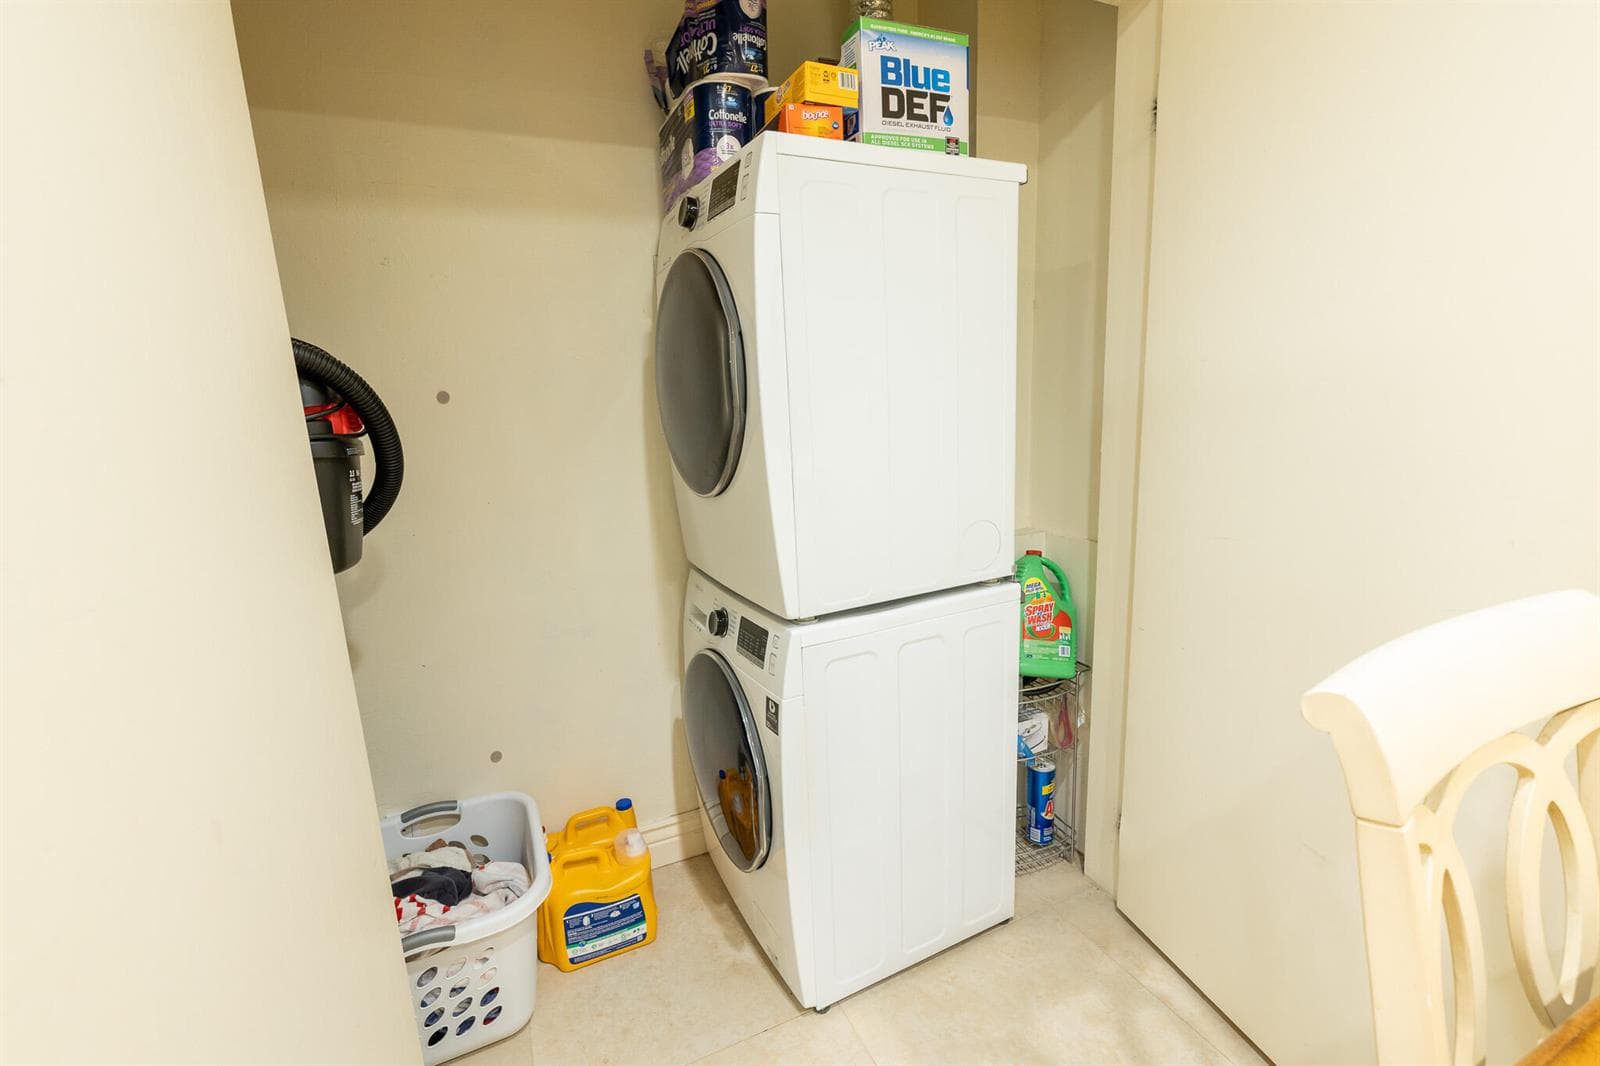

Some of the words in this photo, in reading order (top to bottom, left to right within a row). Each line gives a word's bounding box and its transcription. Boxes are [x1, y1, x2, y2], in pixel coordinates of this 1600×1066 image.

[732, 32, 767, 51] Cottonelle
[868, 40, 898, 51] PEAK
[880, 55, 950, 93] Blue
[881, 87, 950, 123] DEF
[708, 109, 747, 123] Cottonelle
[803, 111, 829, 120] bounce
[882, 120, 904, 128] DIESEL
[905, 122, 933, 130] EXHAUST
[1025, 602, 1054, 616] SPRAY
[1027, 613, 1052, 625] WASH
